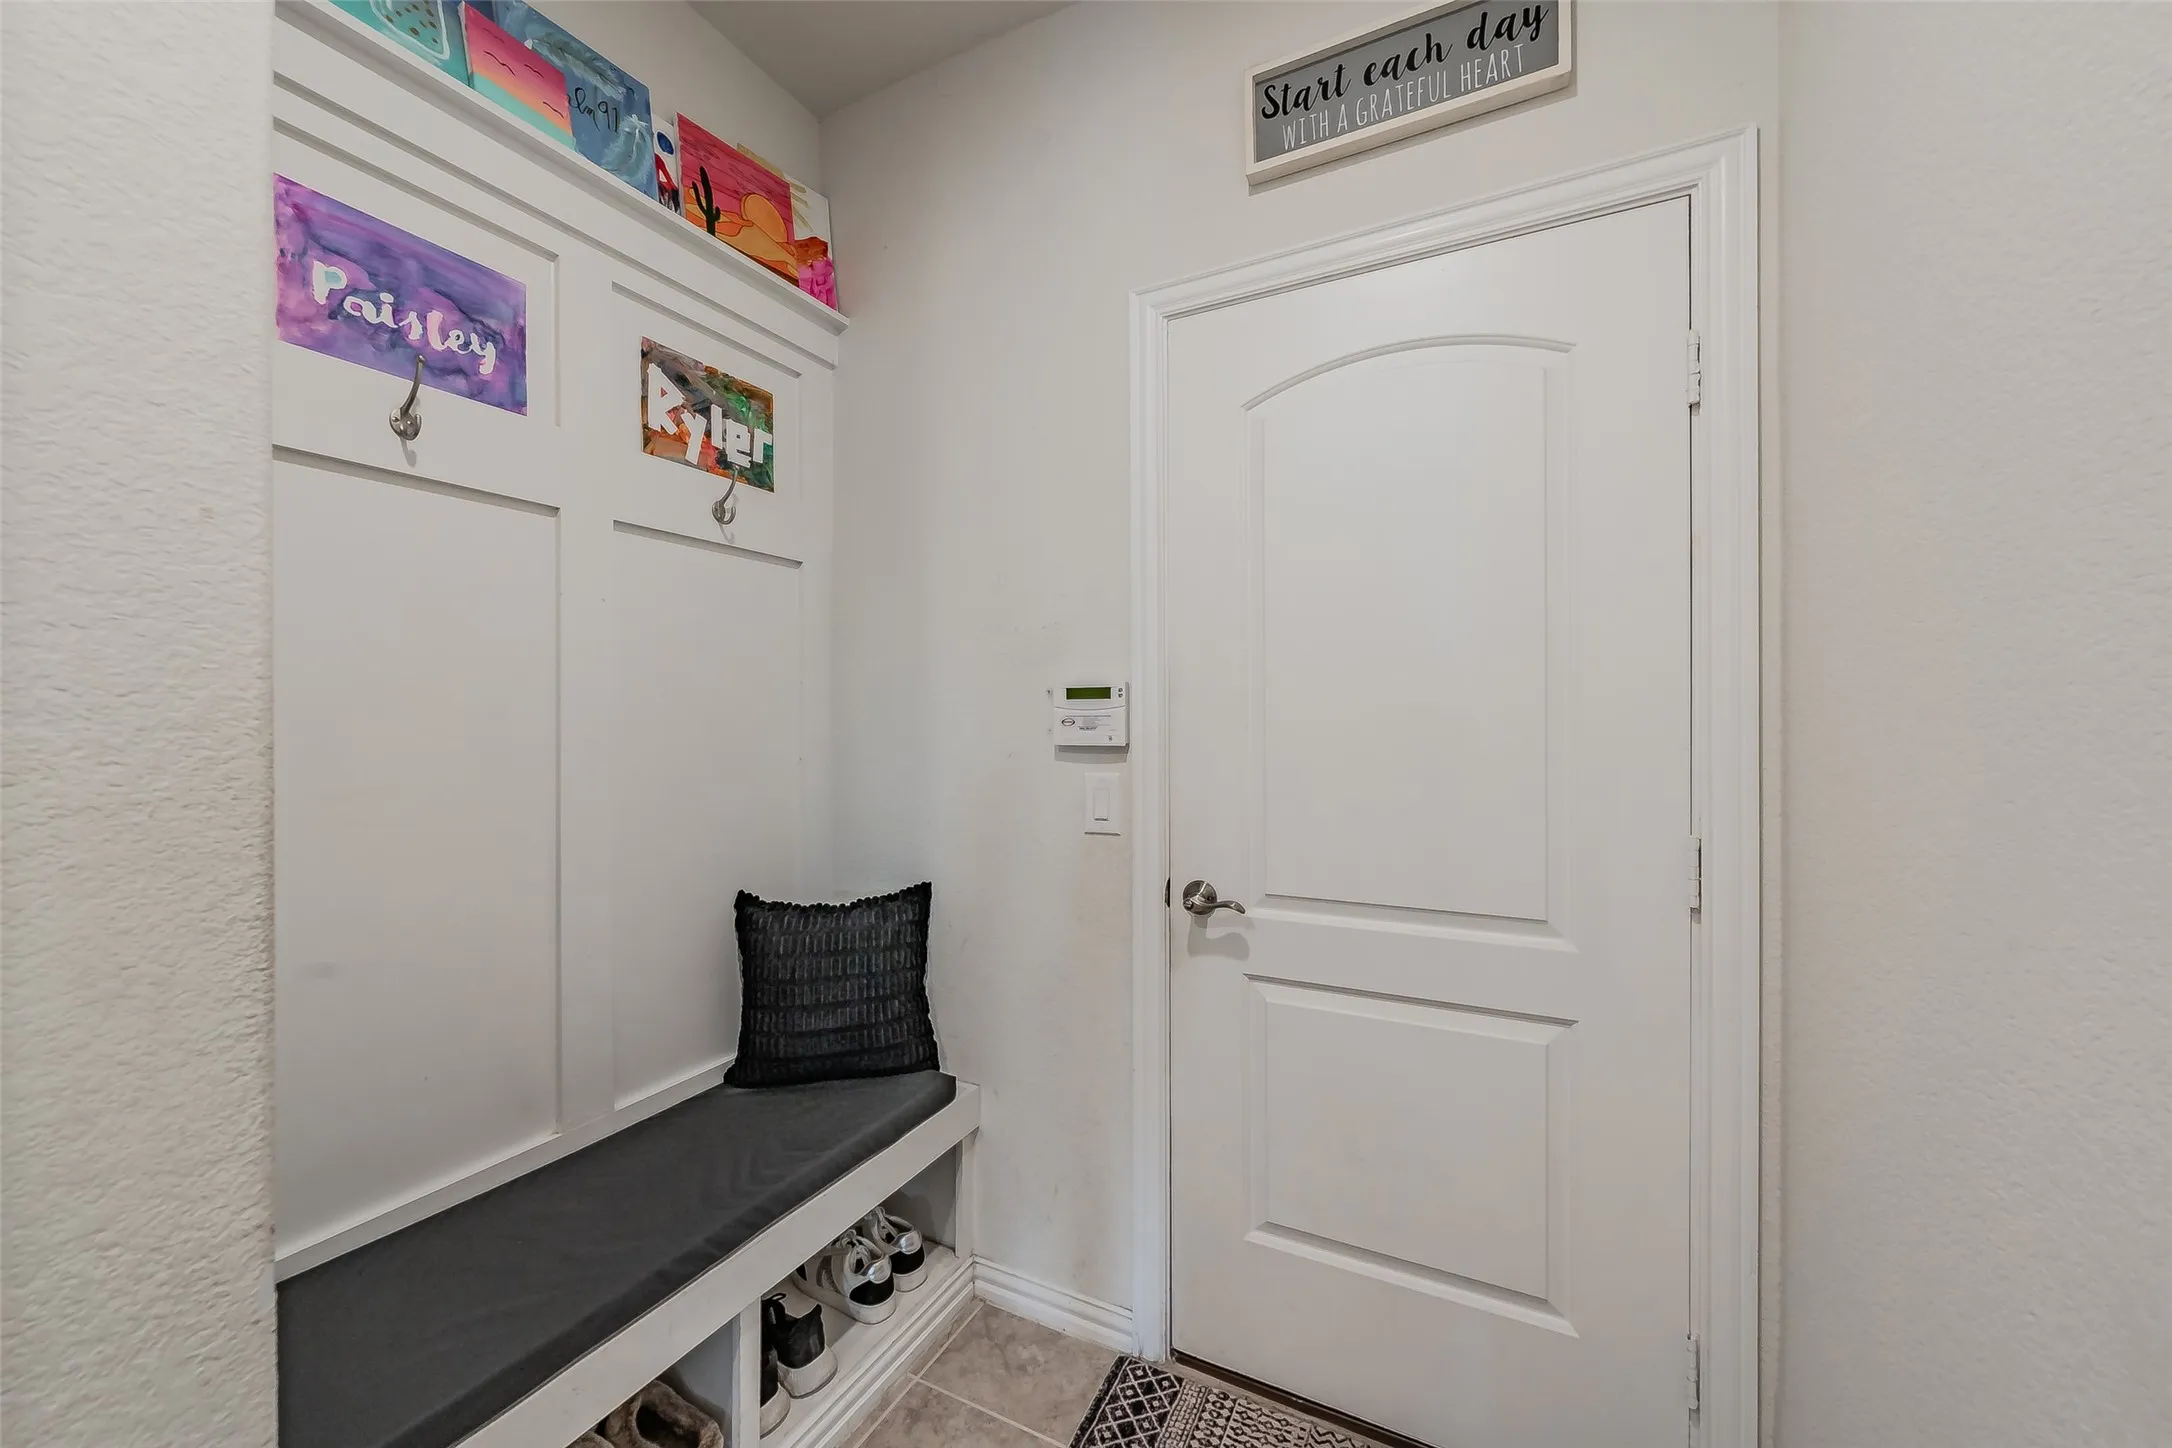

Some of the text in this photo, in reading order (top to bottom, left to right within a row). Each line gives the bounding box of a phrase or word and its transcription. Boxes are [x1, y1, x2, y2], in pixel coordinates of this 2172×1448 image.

[1261, 4, 1549, 120] Start each day
[1282, 43, 1524, 151] WITH A GRATEFUL HEART
[312, 259, 496, 375] Paisley
[646, 362, 774, 469] Ryler
